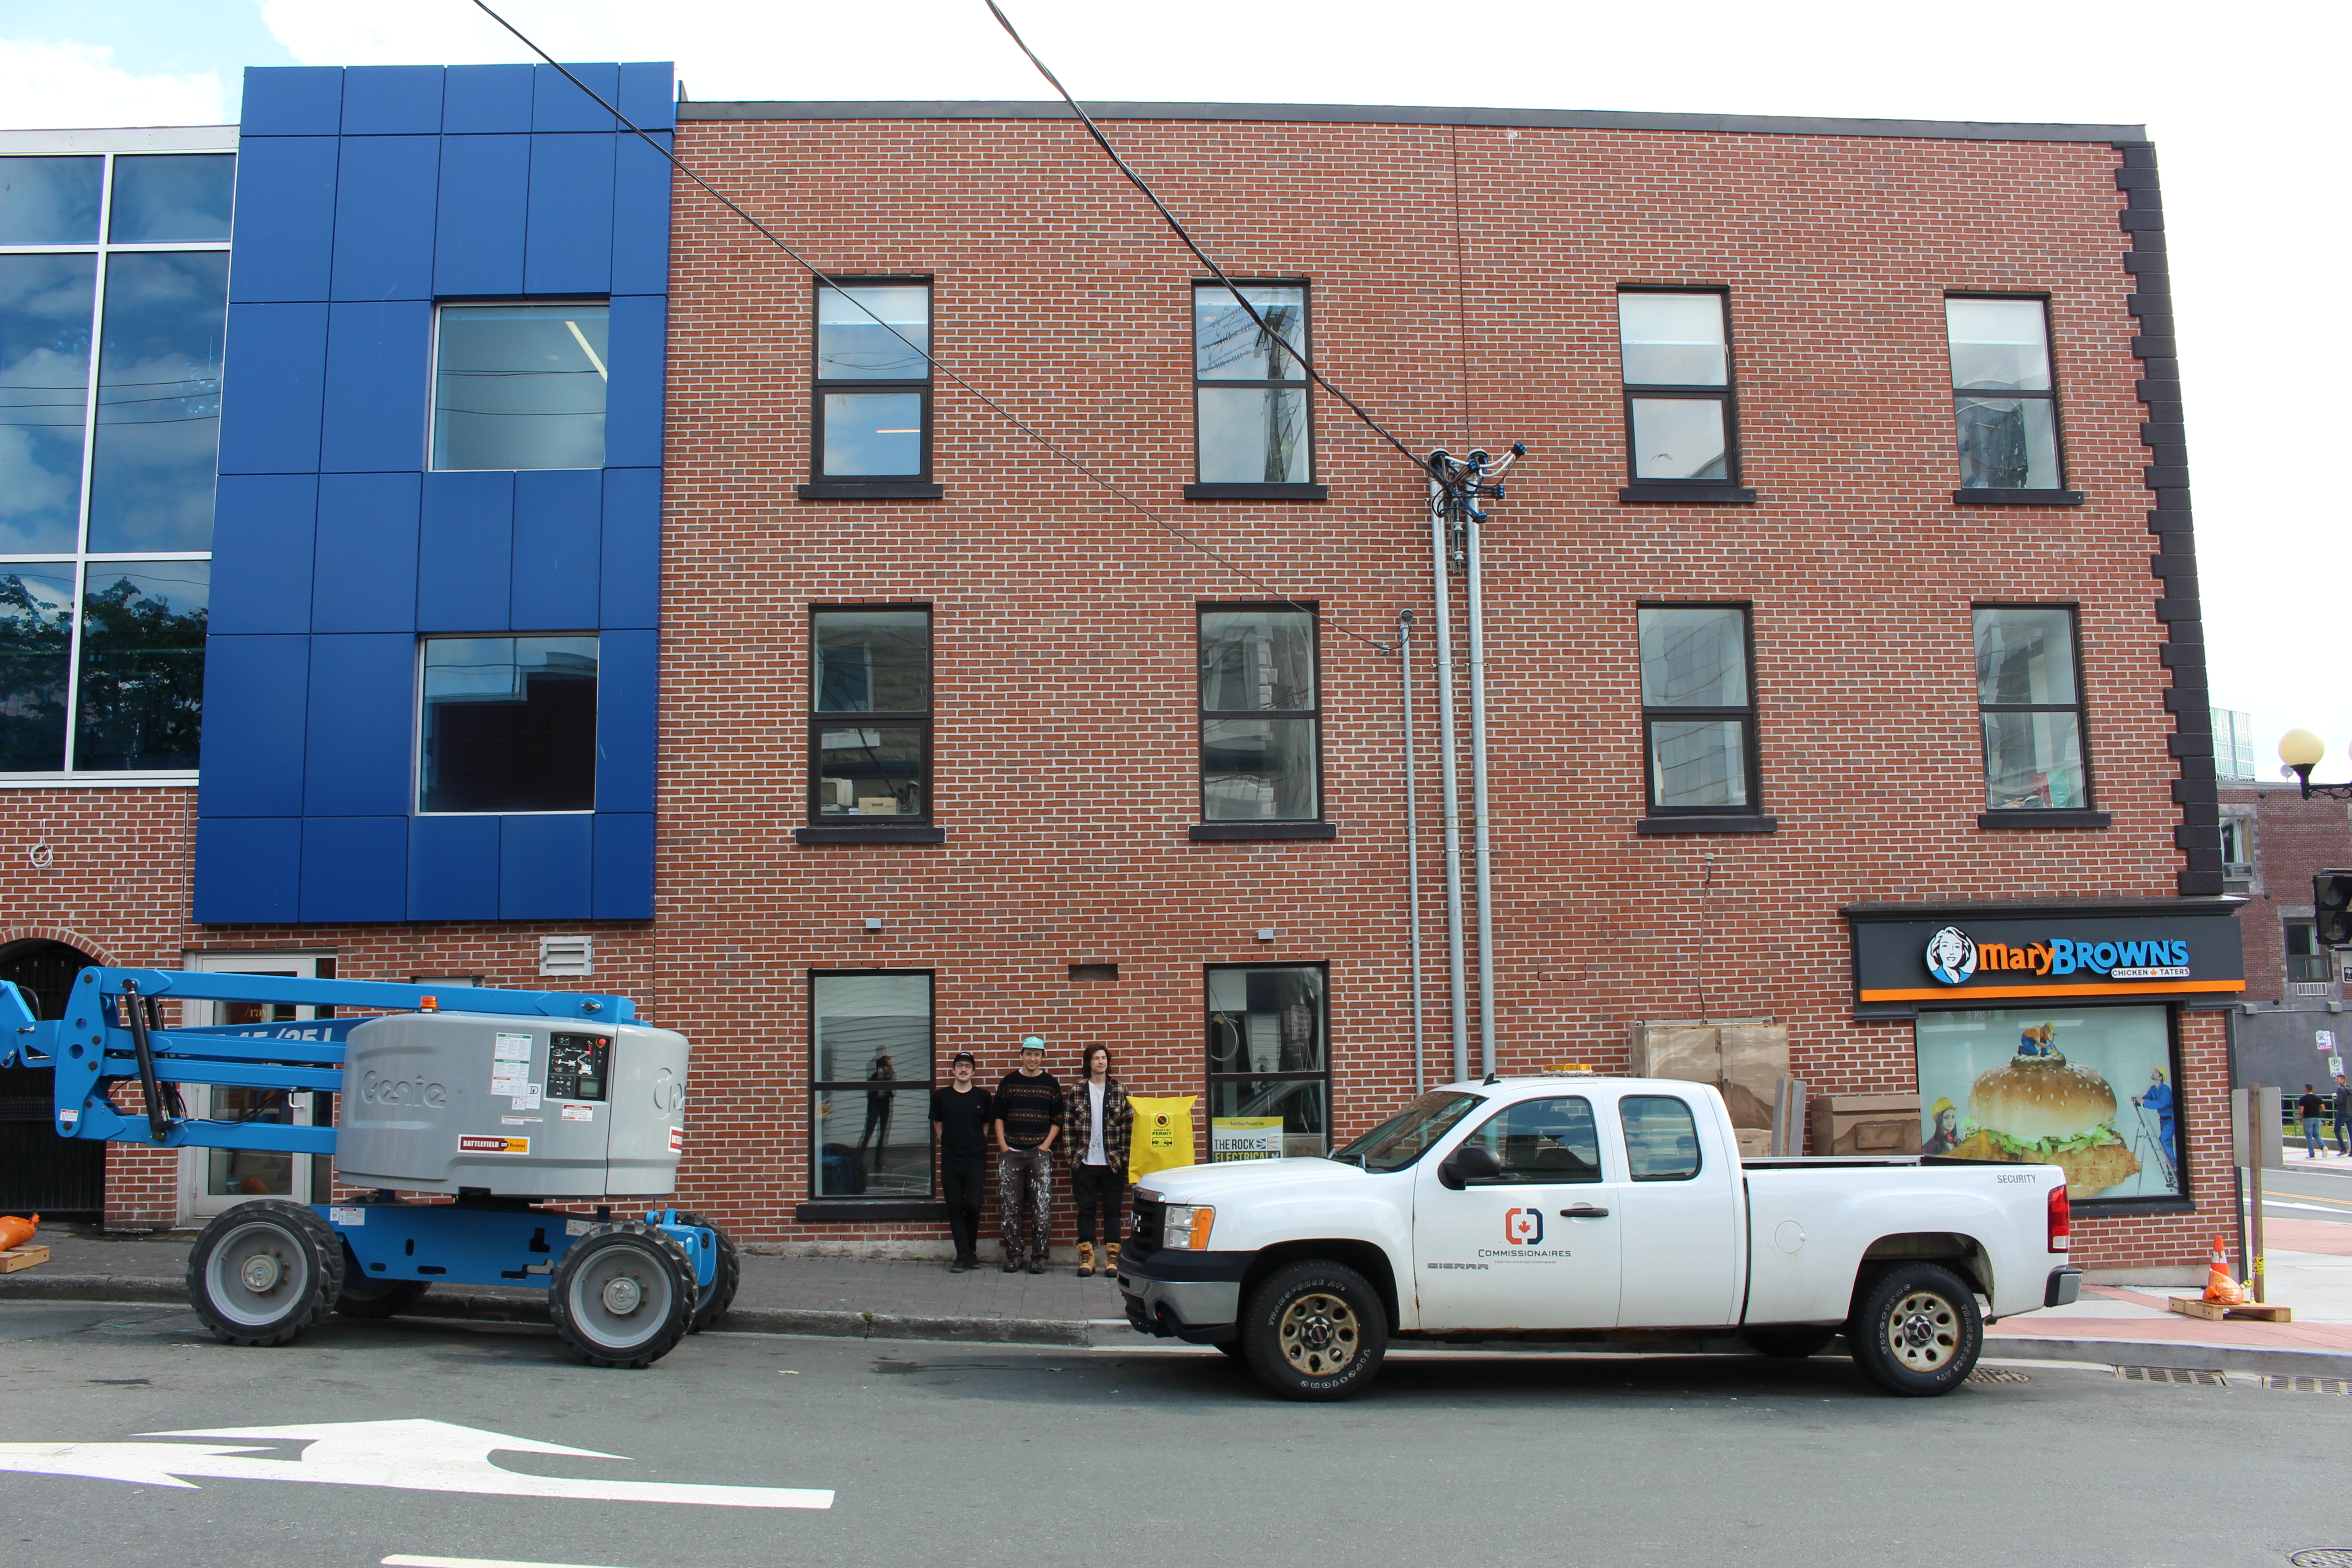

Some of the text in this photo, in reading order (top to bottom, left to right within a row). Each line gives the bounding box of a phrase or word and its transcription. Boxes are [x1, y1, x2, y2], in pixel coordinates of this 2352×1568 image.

[362, 1070, 446, 1108] Genie
[1214, 1139, 1254, 1149] THE ROCK
[1997, 1174, 2036, 1184] SECURITY
